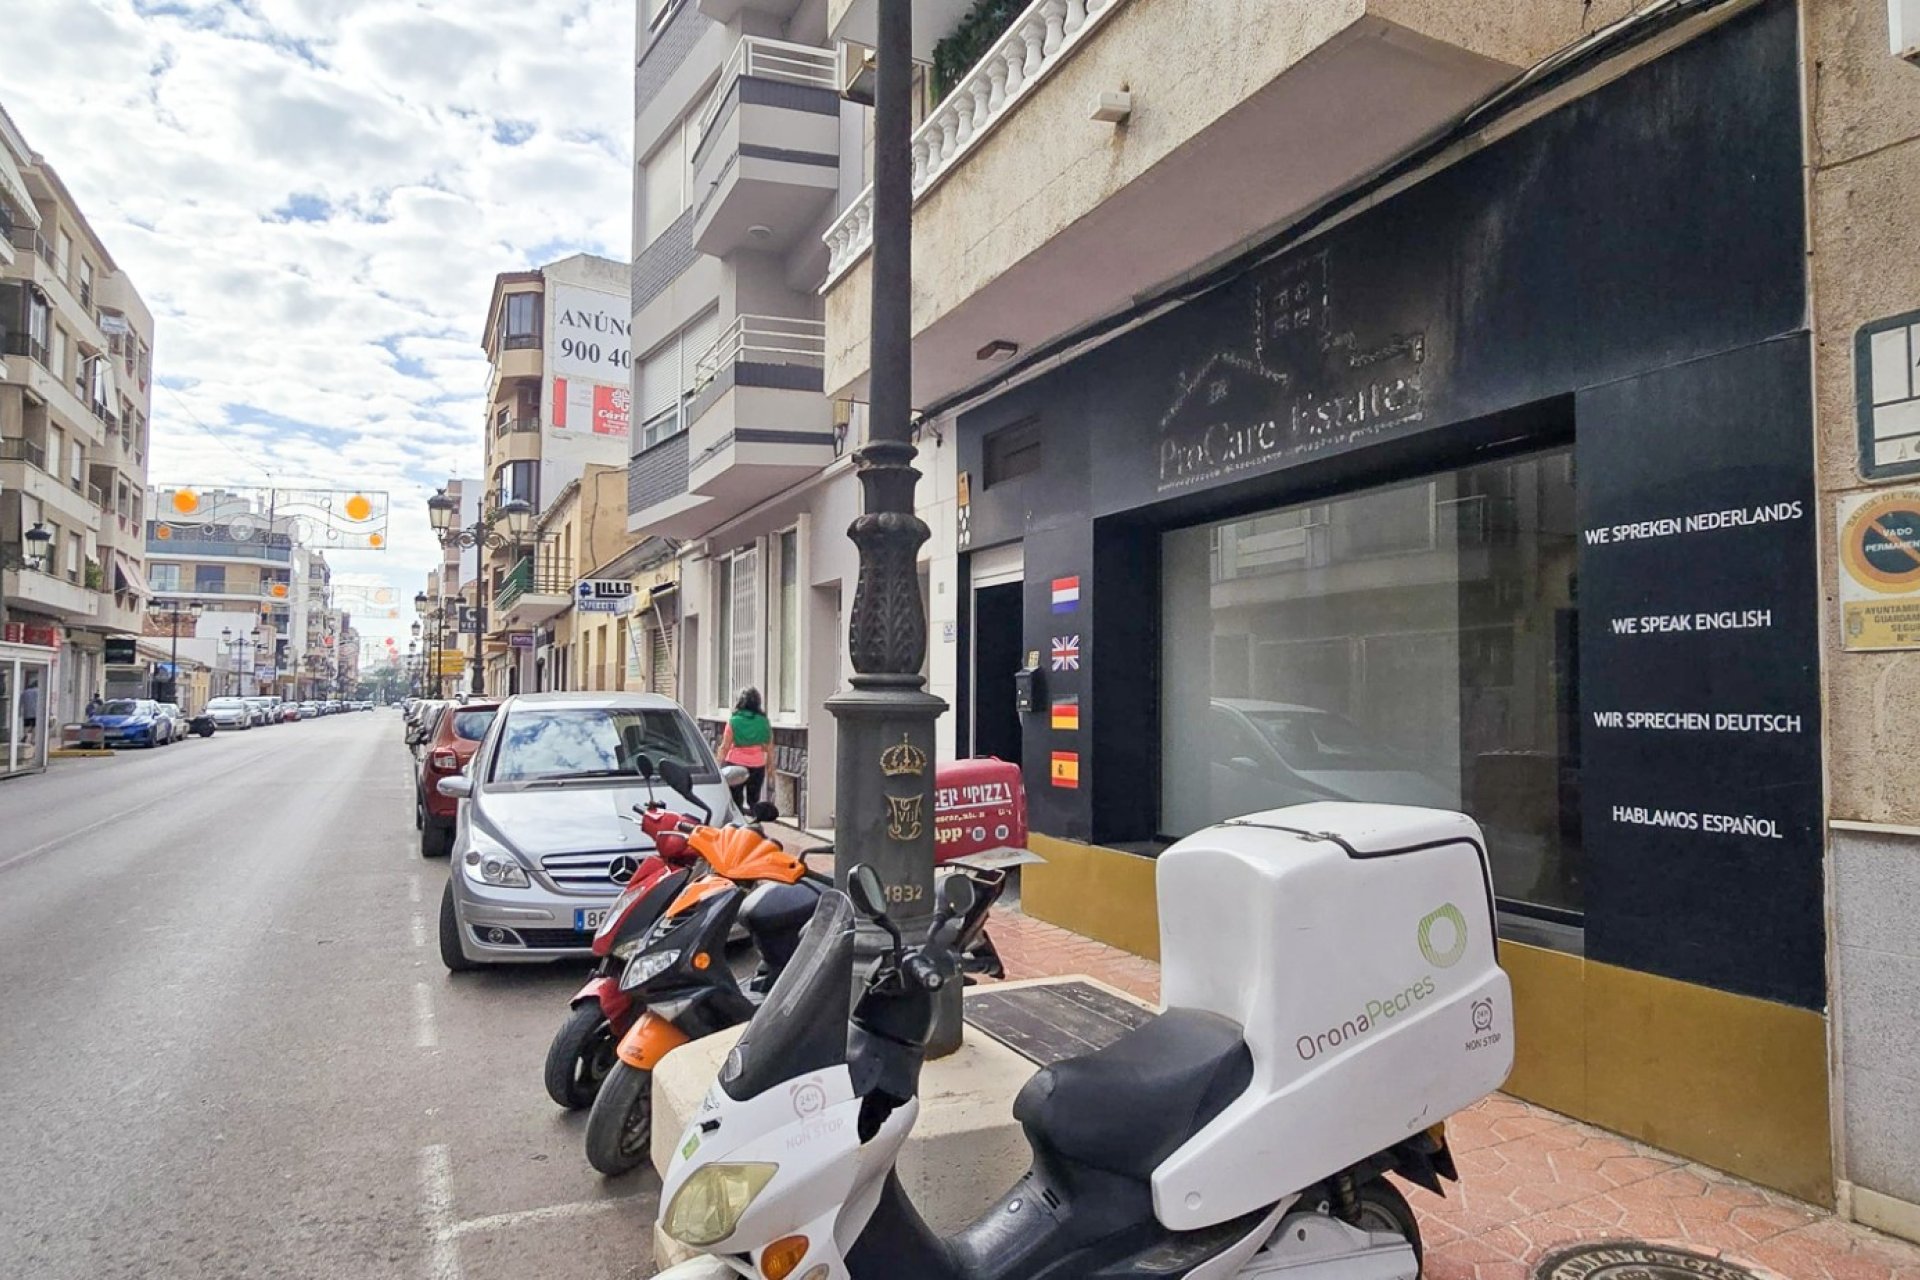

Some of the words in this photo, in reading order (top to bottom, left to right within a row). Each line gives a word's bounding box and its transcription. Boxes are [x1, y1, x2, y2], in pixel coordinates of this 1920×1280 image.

[561, 338, 600, 364] 900
[1585, 528, 1610, 545] WE
[1612, 517, 1682, 543] SPREKEN
[1685, 501, 1803, 533] NEDERLANDS
[1882, 527, 1913, 537] VADO
[595, 582, 631, 598] LILLO
[1612, 618, 1637, 634] WE
[1641, 614, 1690, 633] SPEAK
[1695, 609, 1771, 630] ENGLISH
[1593, 711, 1623, 728] WIR
[1626, 711, 1711, 730] SPRECHEN
[1715, 714, 1801, 733] DEUTSCH
[1612, 805, 1698, 831] HABLAMOS
[1702, 813, 1783, 839] ESPAÑOL
[884, 884, 923, 903] 1832
[1296, 975, 1436, 1061] OronaPecres
[1465, 1038, 1482, 1051] NON
[1482, 1033, 1501, 1047] STOP
[785, 1131, 811, 1151] NON
[814, 1118, 843, 1137] STOP
